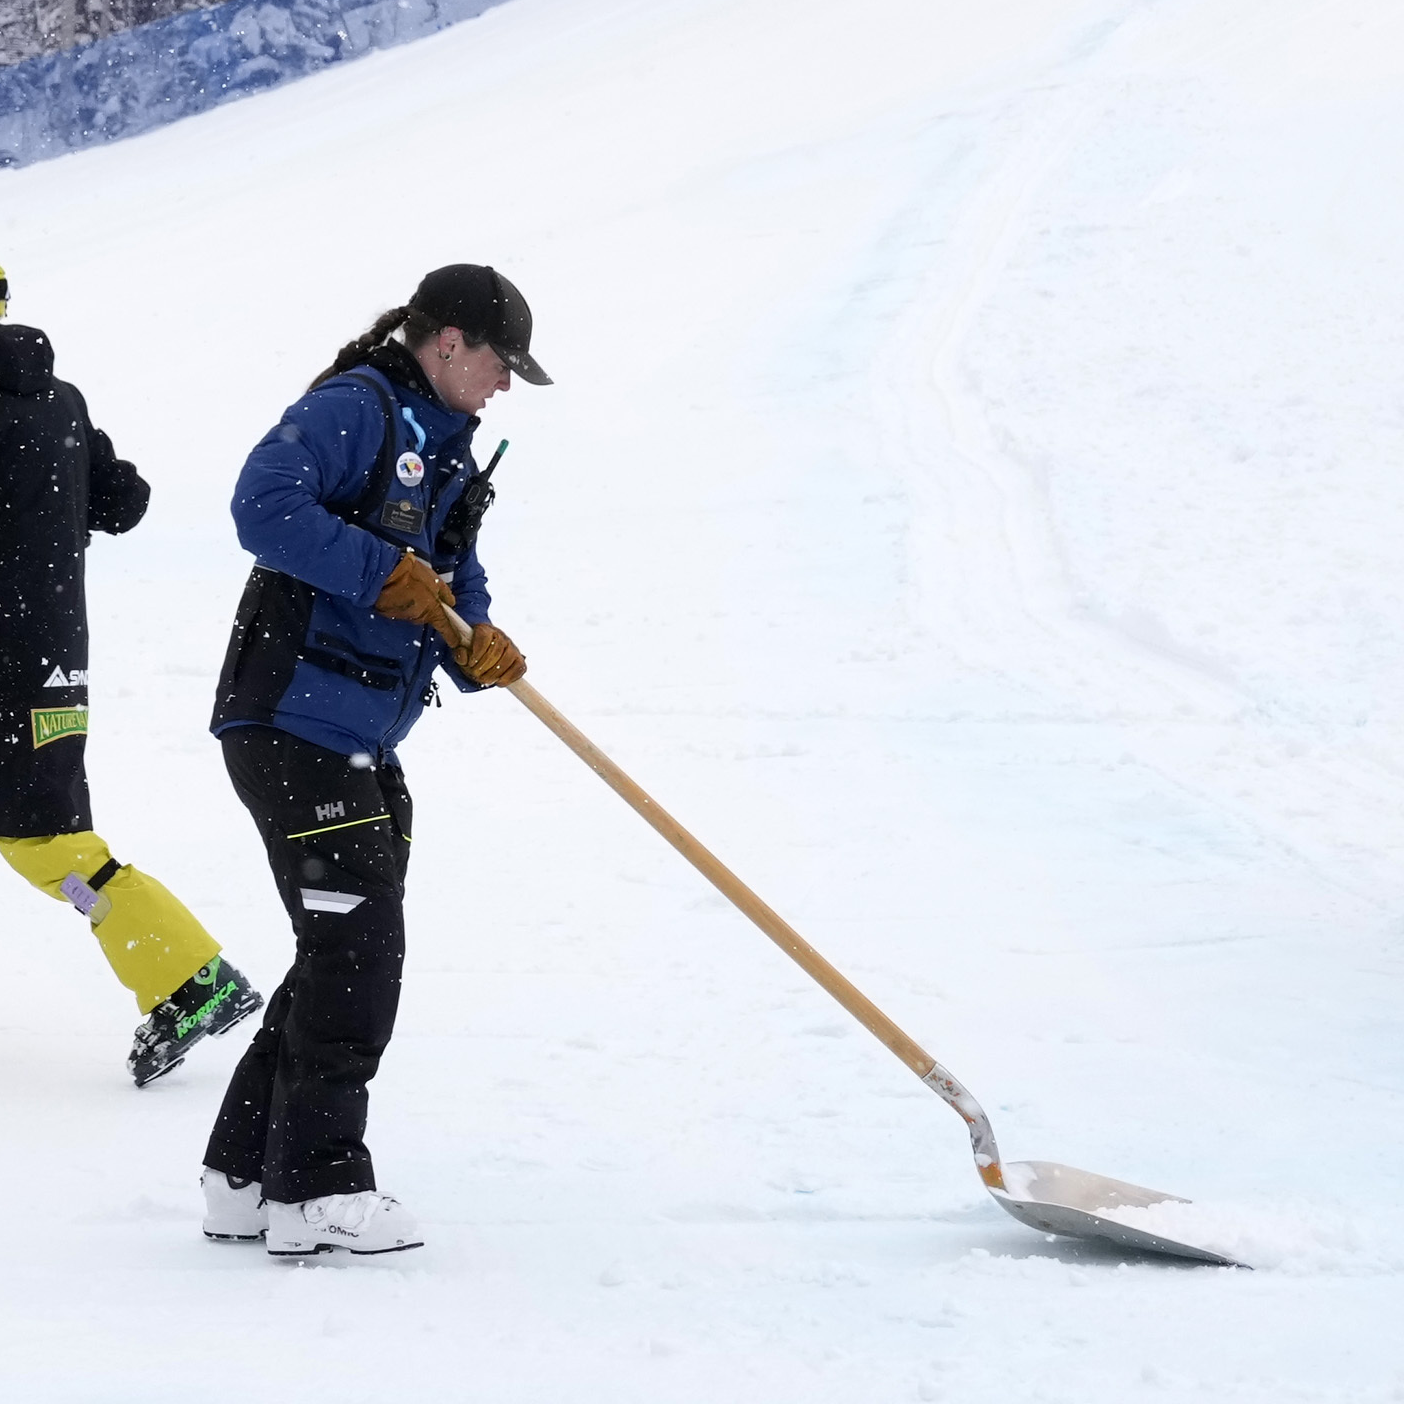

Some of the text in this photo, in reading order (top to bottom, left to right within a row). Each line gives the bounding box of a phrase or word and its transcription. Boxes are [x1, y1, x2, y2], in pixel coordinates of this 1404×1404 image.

[38, 712, 77, 740] NATURE
[315, 801, 345, 821] HH
[177, 980, 237, 1039] NORDICA
